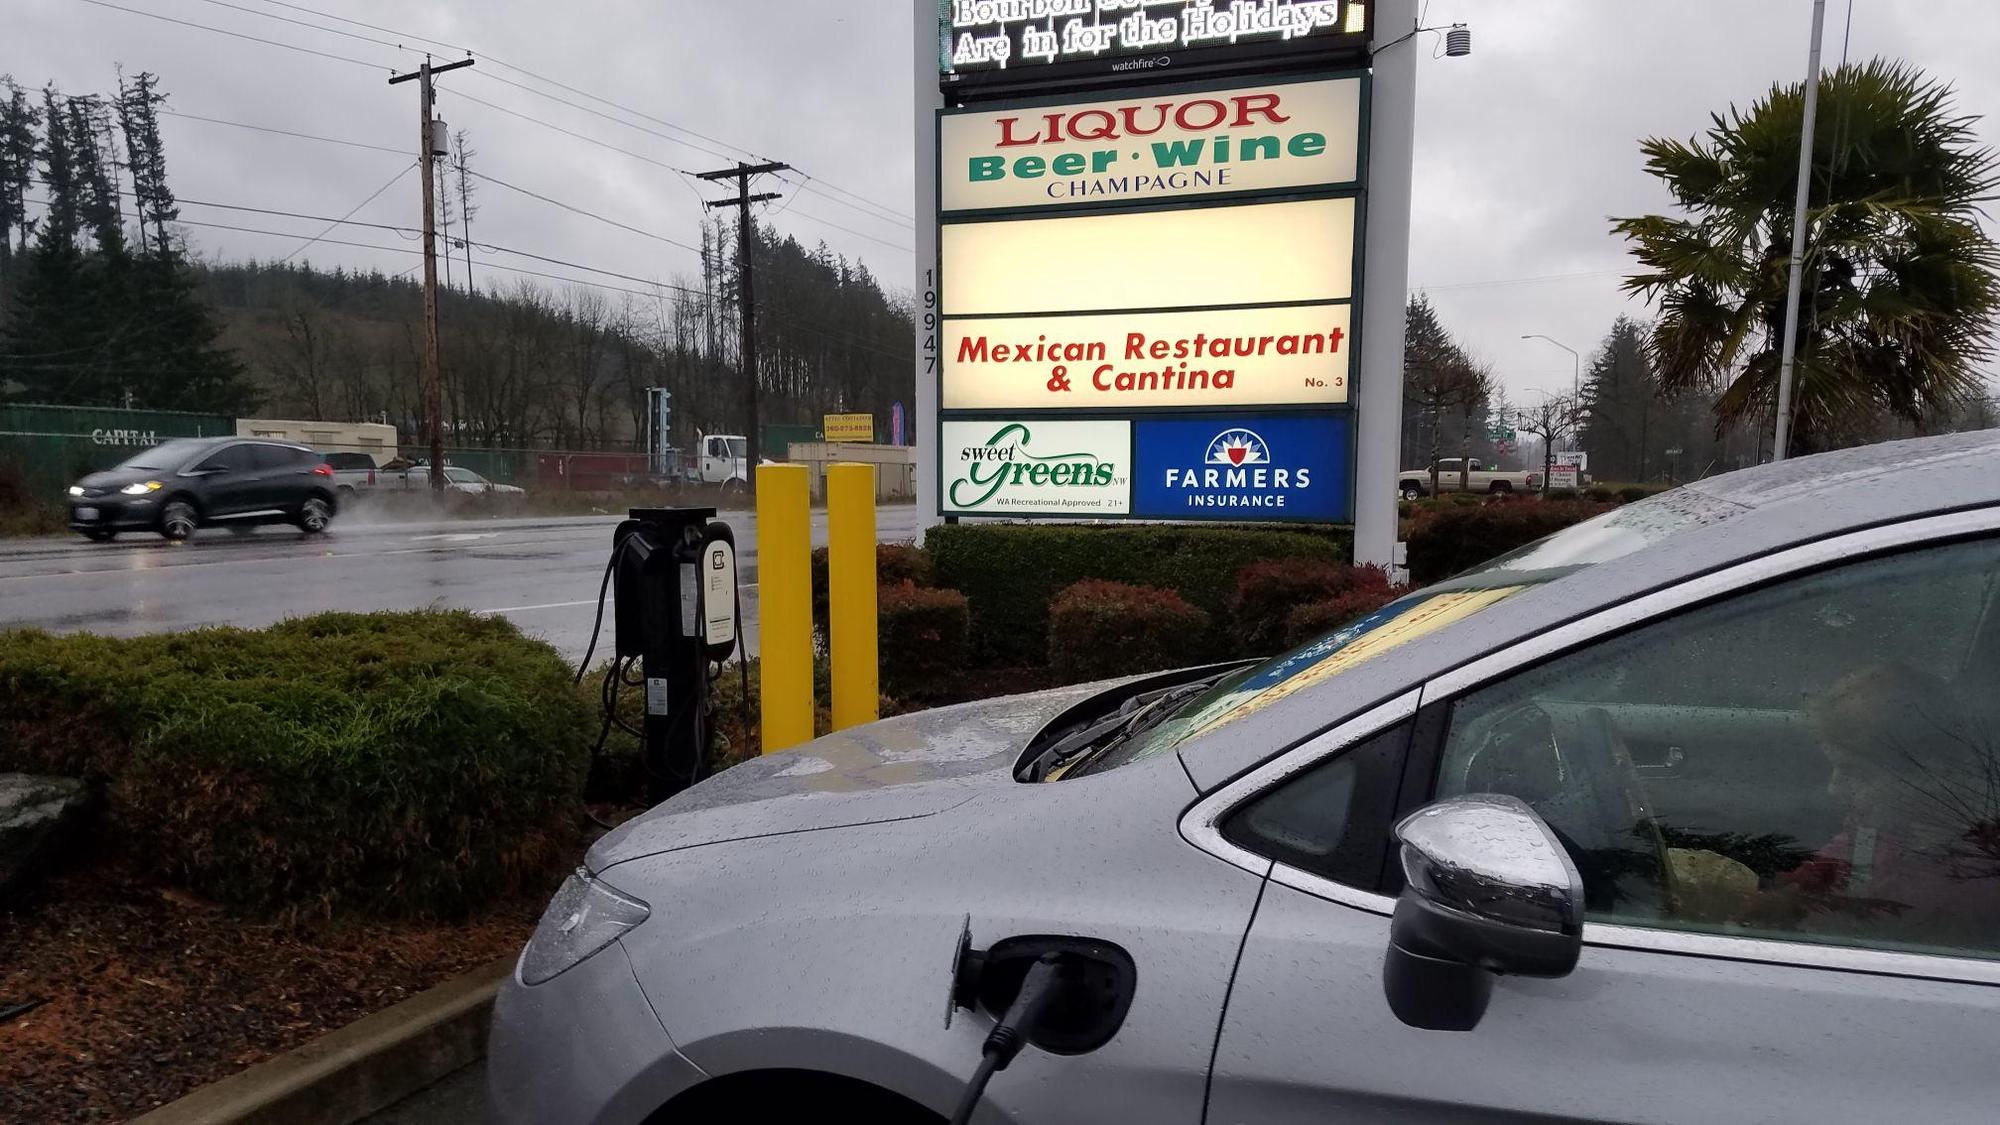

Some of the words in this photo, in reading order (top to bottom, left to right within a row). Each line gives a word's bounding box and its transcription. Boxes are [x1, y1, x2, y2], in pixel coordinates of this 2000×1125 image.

[955, 32, 1011, 66] Are
[1023, 26, 1058, 58] in
[1063, 18, 1117, 53] for
[1121, 11, 1177, 46] the
[1182, 1, 1338, 40] Holidays
[1112, 58, 1154, 71] watchfire
[996, 93, 1290, 148] LIQUOR
[969, 150, 1118, 182] Beer
[1046, 168, 1232, 199] CHAMPAGNE
[957, 335, 1106, 363] Mexican
[1124, 327, 1344, 360] Restaurant
[1046, 366, 1072, 393] &
[1092, 363, 1235, 392] Cantina
[1305, 376, 1329, 388] No.
[1335, 376, 1343, 387] 3
[92, 428, 158, 446] CAPITAL
[418, 458, 453, 466] CAAL
[961, 442, 1016, 462] sweet
[949, 423, 1115, 508] Greens
[1166, 468, 1311, 489] FARMERS
[996, 497, 1010, 506] WA
[1011, 497, 1060, 507] Recreational
[1061, 498, 1101, 508] Approved
[1107, 498, 1123, 507] 21+
[1188, 494, 1286, 507] INSURANCE
